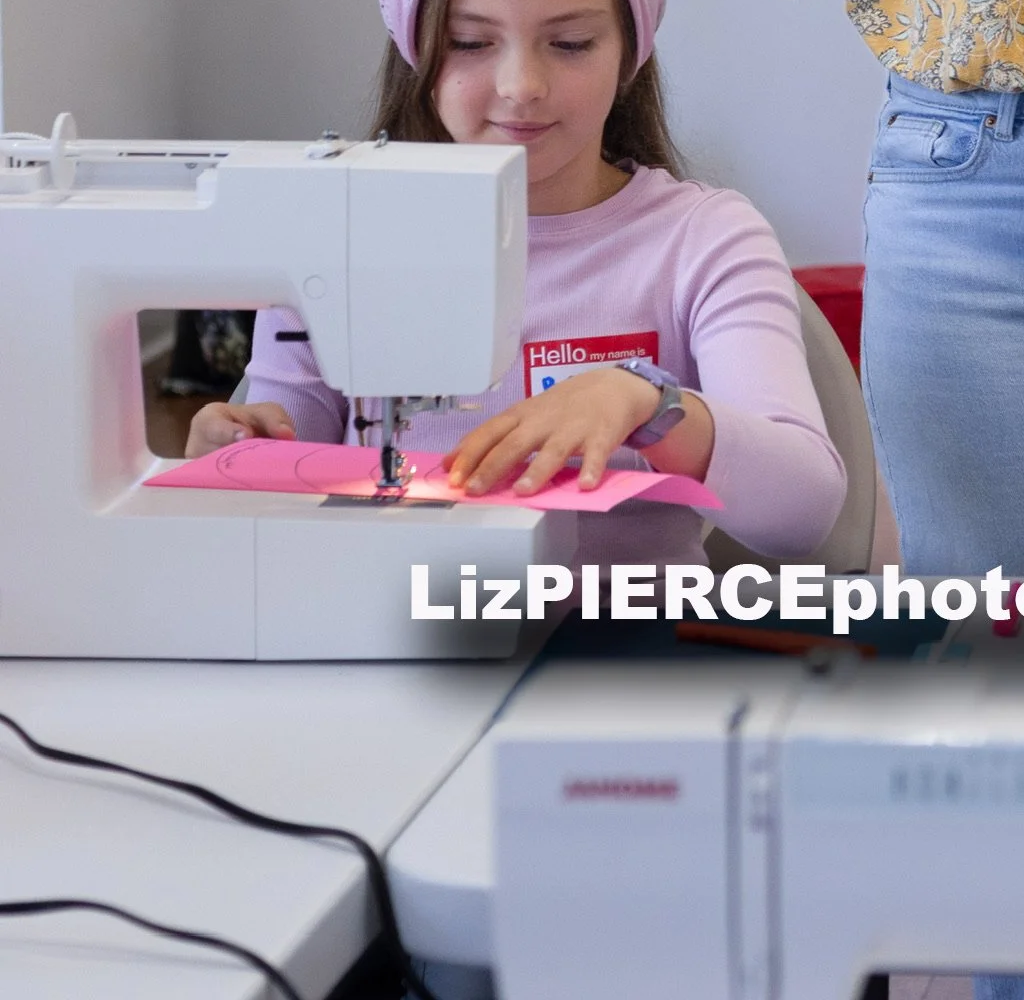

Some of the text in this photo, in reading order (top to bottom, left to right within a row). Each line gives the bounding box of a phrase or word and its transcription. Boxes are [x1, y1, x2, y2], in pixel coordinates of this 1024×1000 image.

[529, 343, 646, 367] Hello my name is
